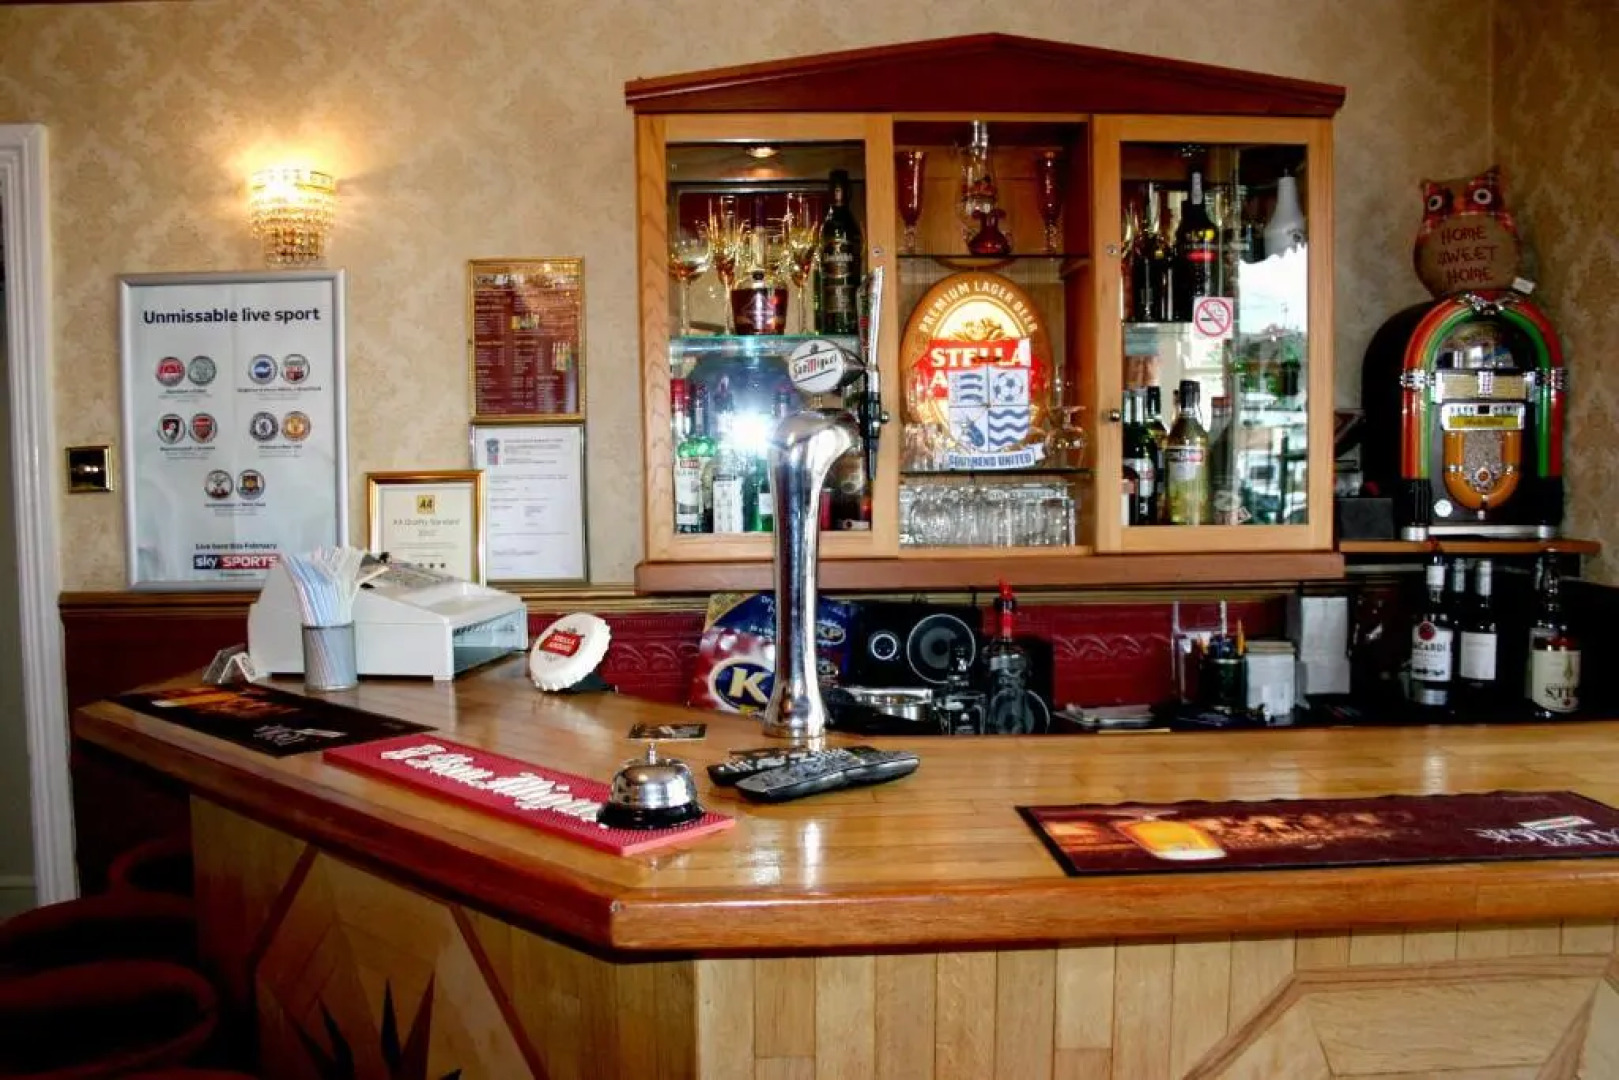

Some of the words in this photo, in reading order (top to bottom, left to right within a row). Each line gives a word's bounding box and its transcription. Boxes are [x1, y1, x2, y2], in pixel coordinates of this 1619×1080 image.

[1441, 226, 1487, 245] HOME
[1437, 245, 1498, 266] SWEET
[1447, 266, 1495, 284] HOME
[918, 282, 970, 333] PREMIUM
[974, 280, 1015, 303] LAGER
[1013, 301, 1038, 333] BEER
[143, 308, 237, 324] Unmissable
[242, 307, 270, 322] live
[274, 307, 320, 325] sport
[195, 555, 219, 569] sky
[222, 556, 278, 568] SPORTS
[1412, 642, 1446, 652] ACARDI
[729, 666, 773, 703] K
